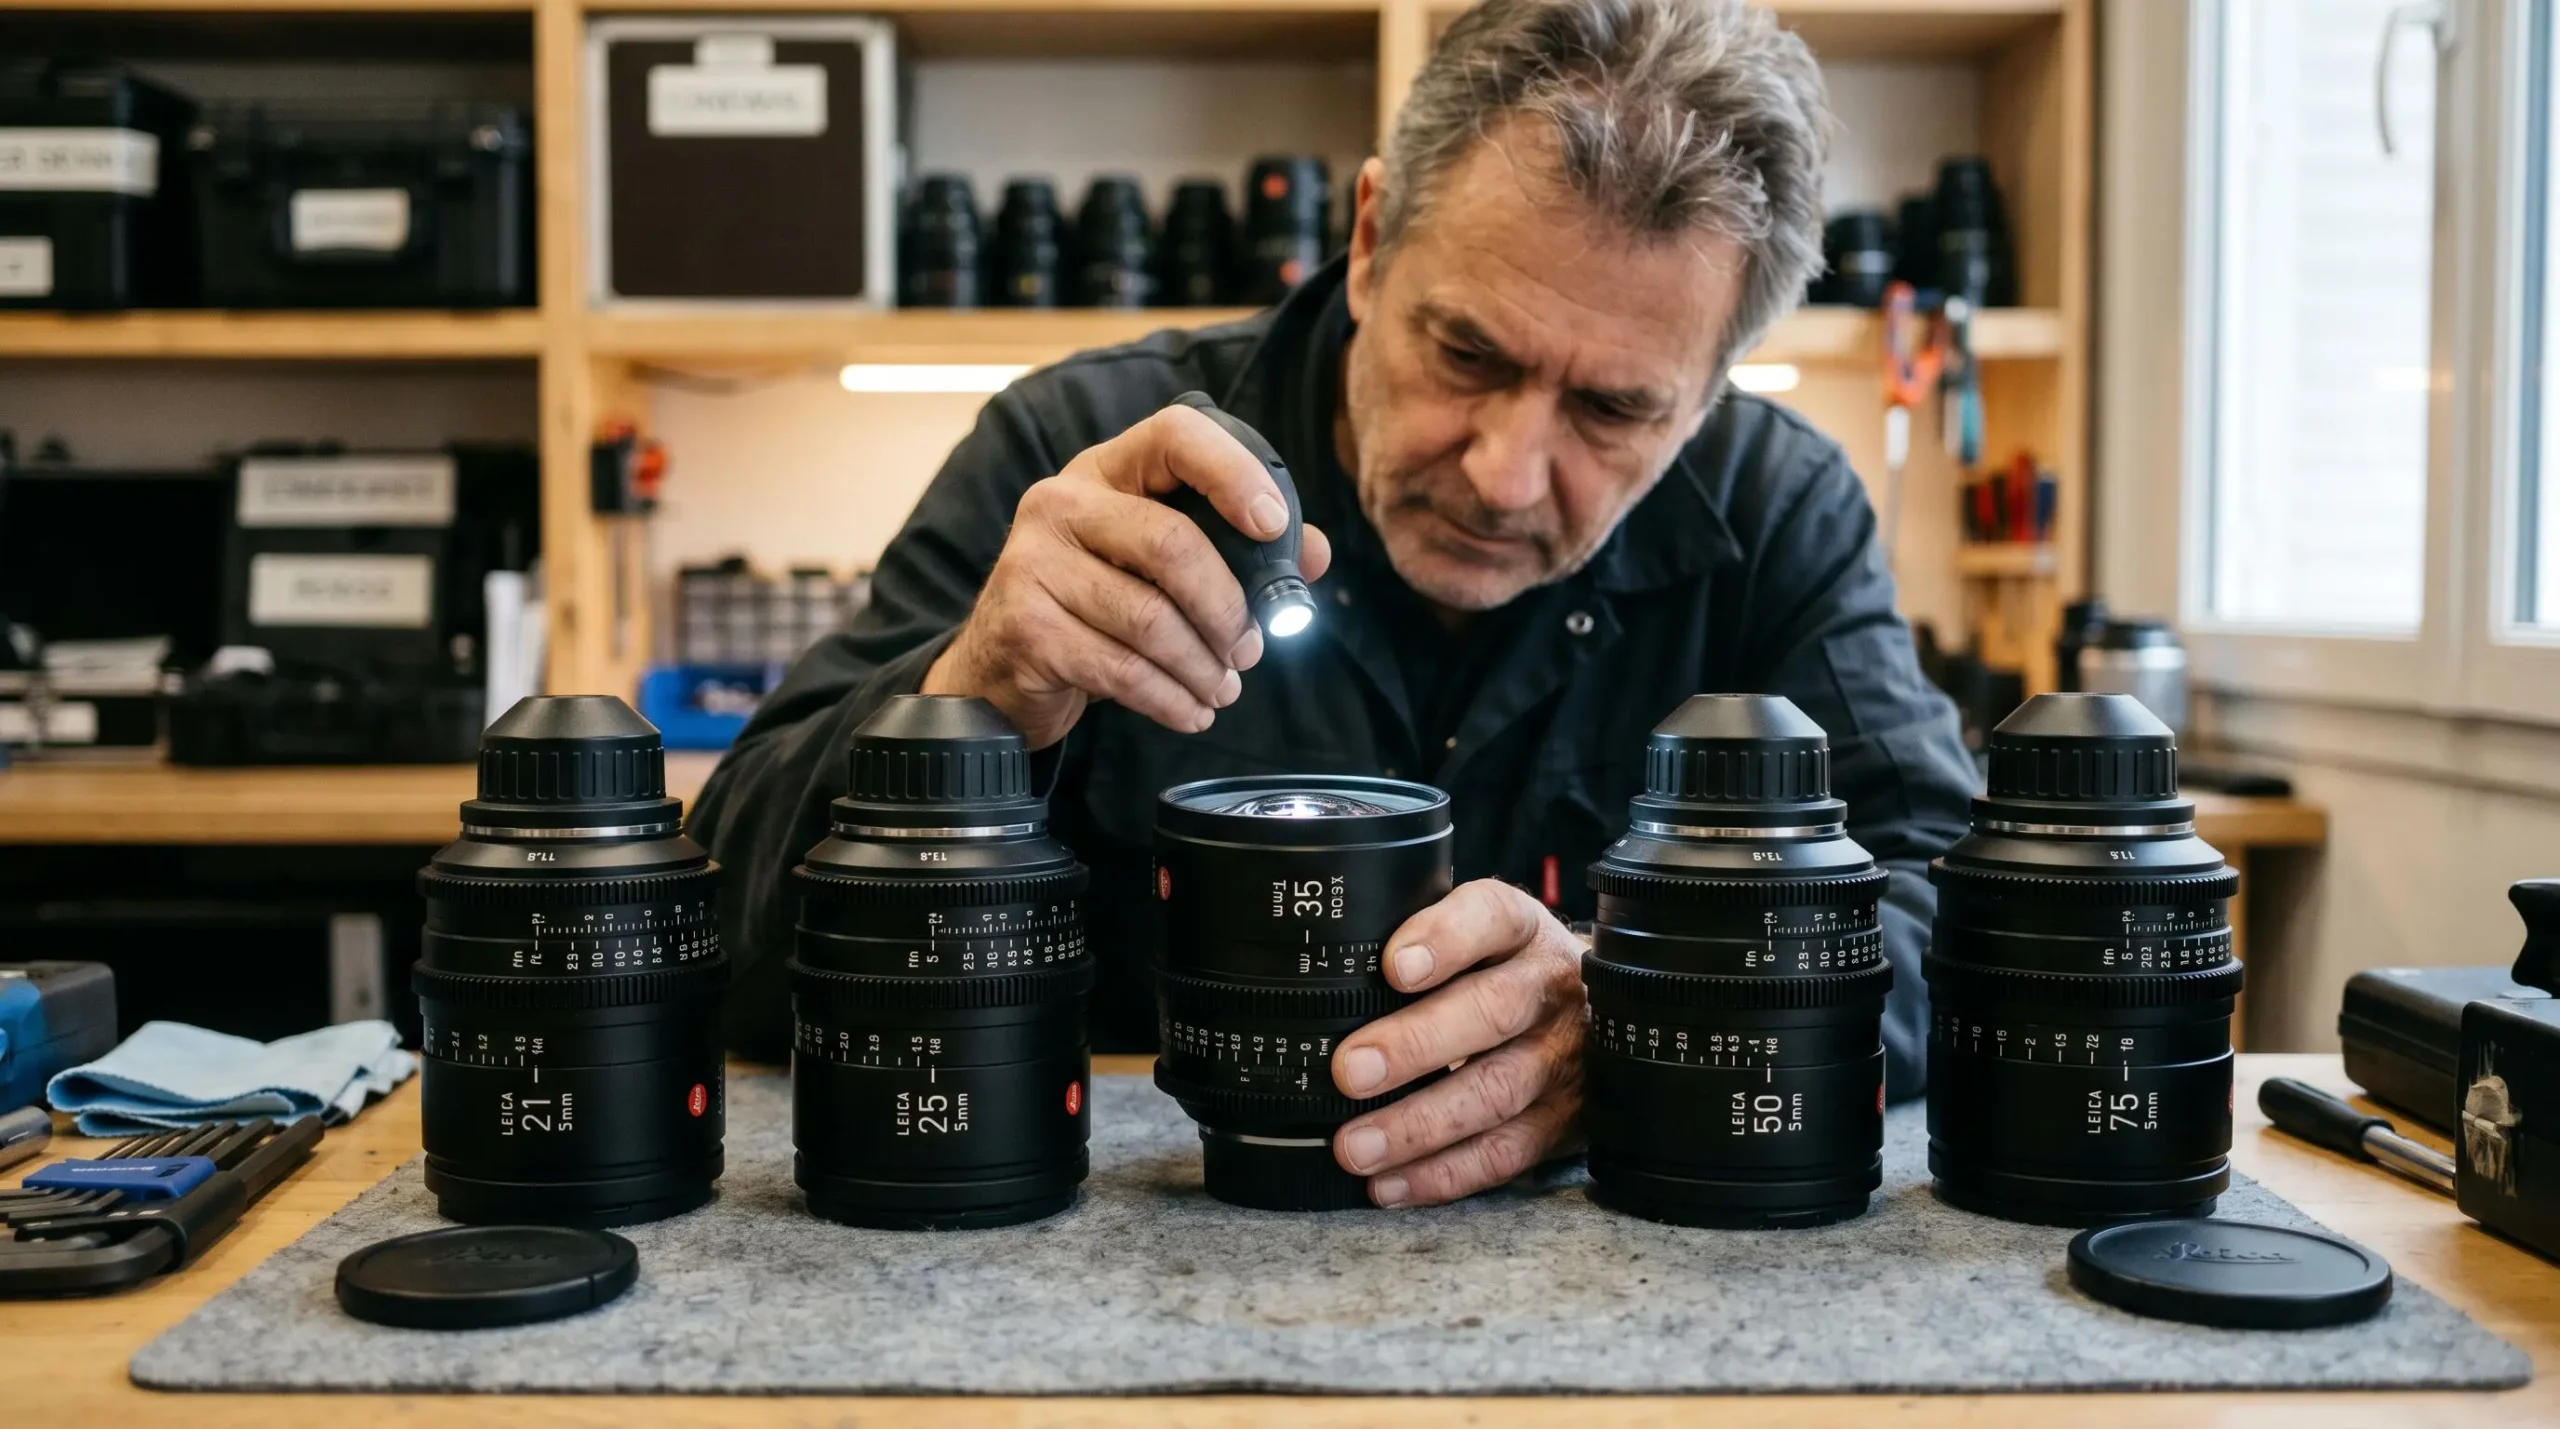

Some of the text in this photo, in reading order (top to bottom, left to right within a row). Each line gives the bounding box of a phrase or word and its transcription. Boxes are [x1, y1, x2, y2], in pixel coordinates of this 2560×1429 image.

[1294, 881, 1322, 916] 35
[501, 1093, 513, 1135] LEICA
[522, 1100, 551, 1131] 21
[559, 1093, 572, 1131] 5mm
[897, 1092, 909, 1135] LEICA
[918, 1095, 947, 1133] 25
[954, 1094, 968, 1131] 5mm
[1732, 1092, 1745, 1135] LEICA
[1754, 1096, 1782, 1133] 50
[1789, 1094, 1802, 1131] 5mm
[2088, 1091, 2101, 1133] LEICA
[2110, 1094, 2138, 1130] 75
[2145, 1093, 2158, 1129] 5mm
